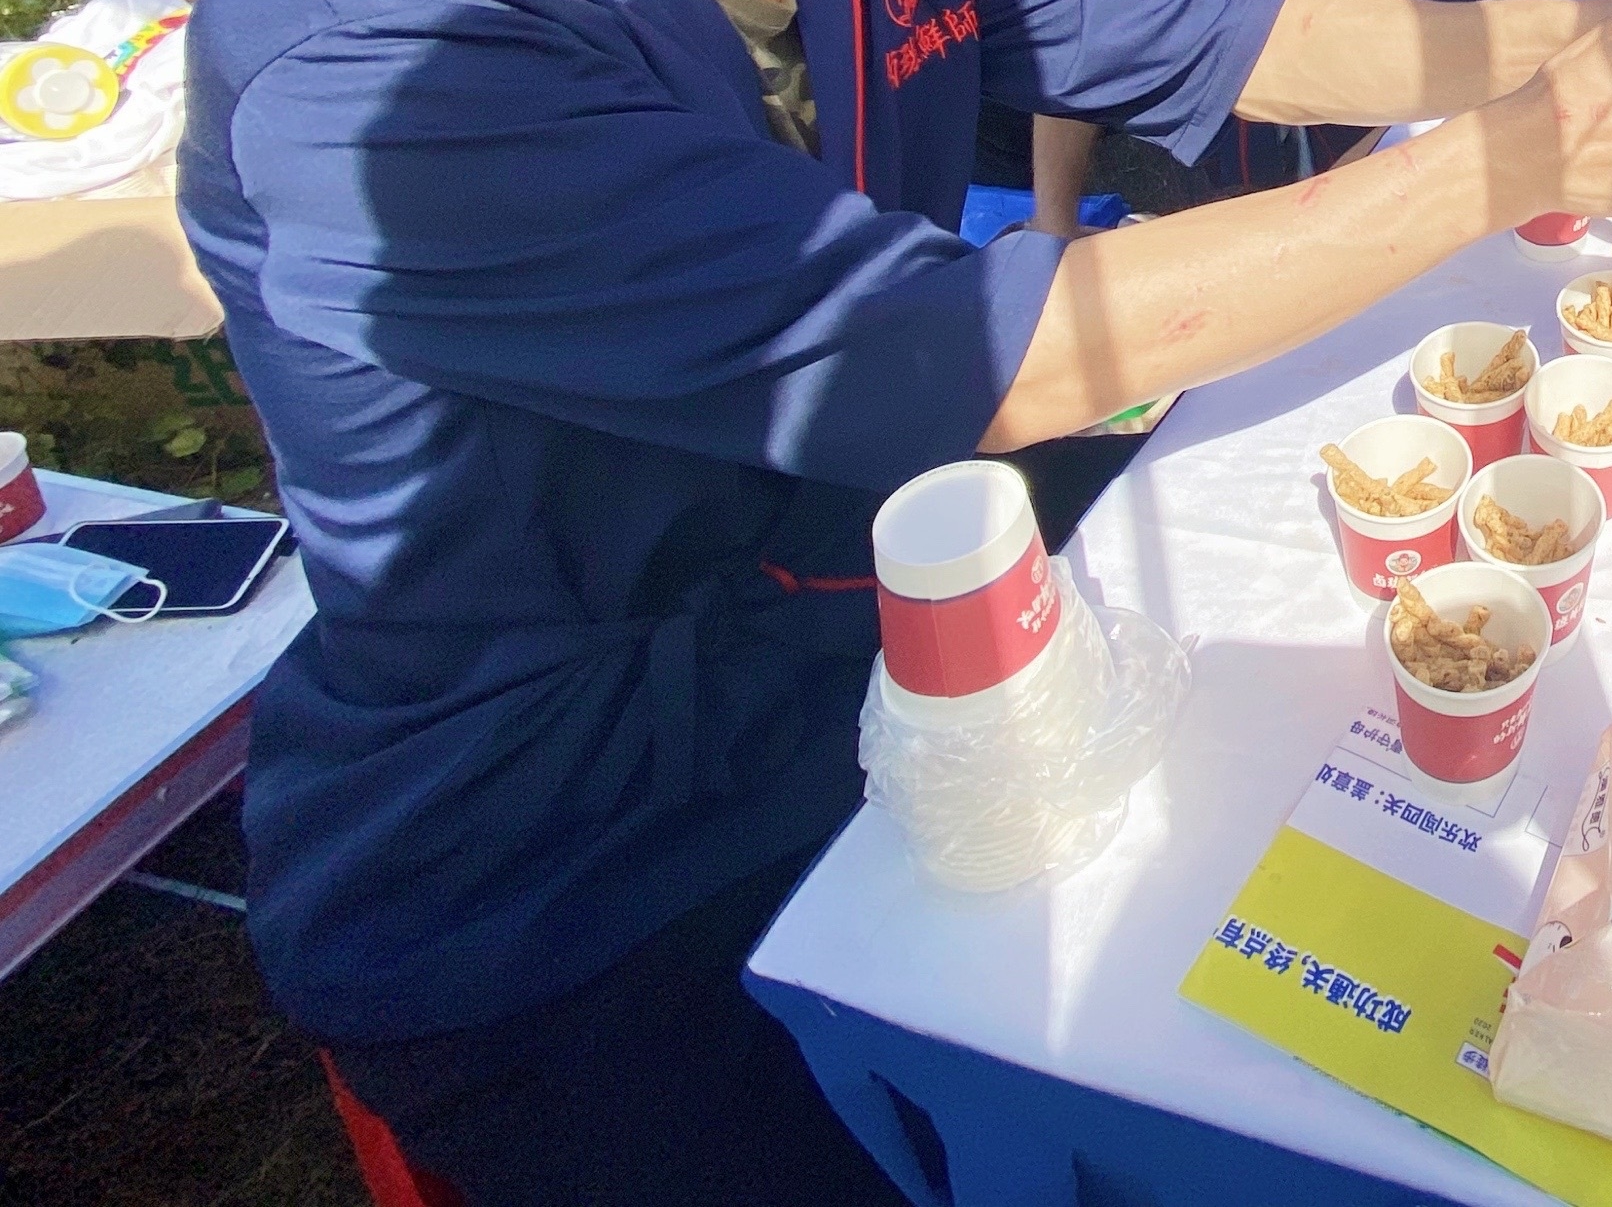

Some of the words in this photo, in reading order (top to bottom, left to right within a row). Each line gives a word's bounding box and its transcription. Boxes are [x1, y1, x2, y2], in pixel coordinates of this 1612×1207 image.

[1213, 917, 1412, 1034] 成功通关，终点有
